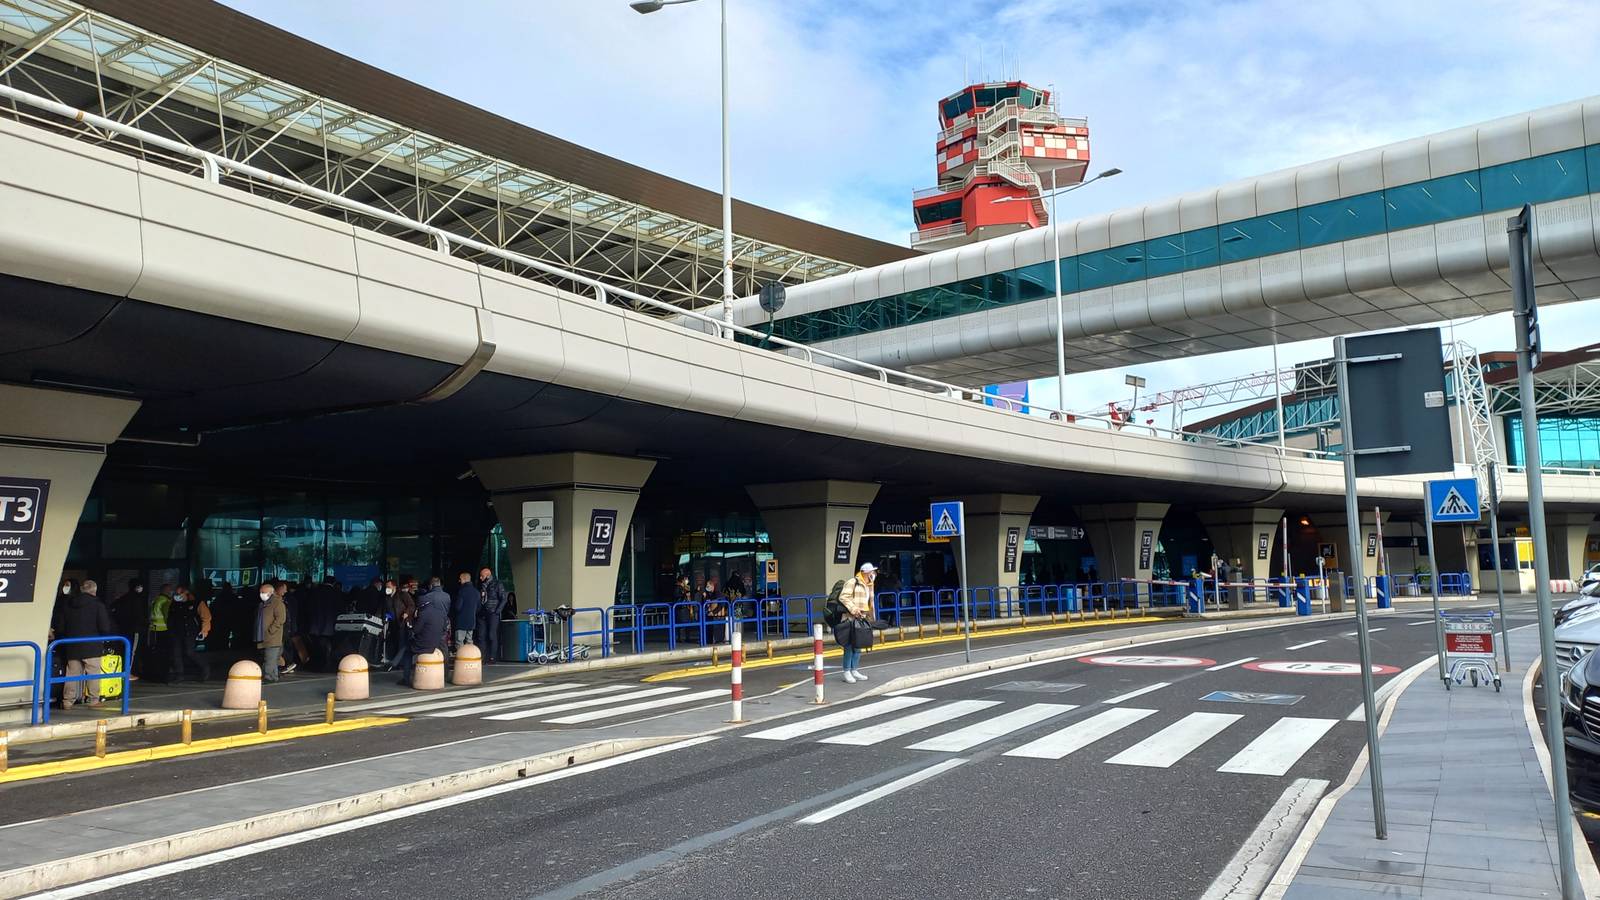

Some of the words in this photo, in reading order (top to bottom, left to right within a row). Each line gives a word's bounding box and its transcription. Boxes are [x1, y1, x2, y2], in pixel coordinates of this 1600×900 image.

[0, 497, 33, 522] T3
[595, 522, 610, 538] T3
[880, 521, 912, 533] Termin
[0, 537, 21, 545] rrivi
[840, 531, 850, 543] T3
[1009, 534, 1017, 544] T3
[0, 548, 24, 556] rivals
